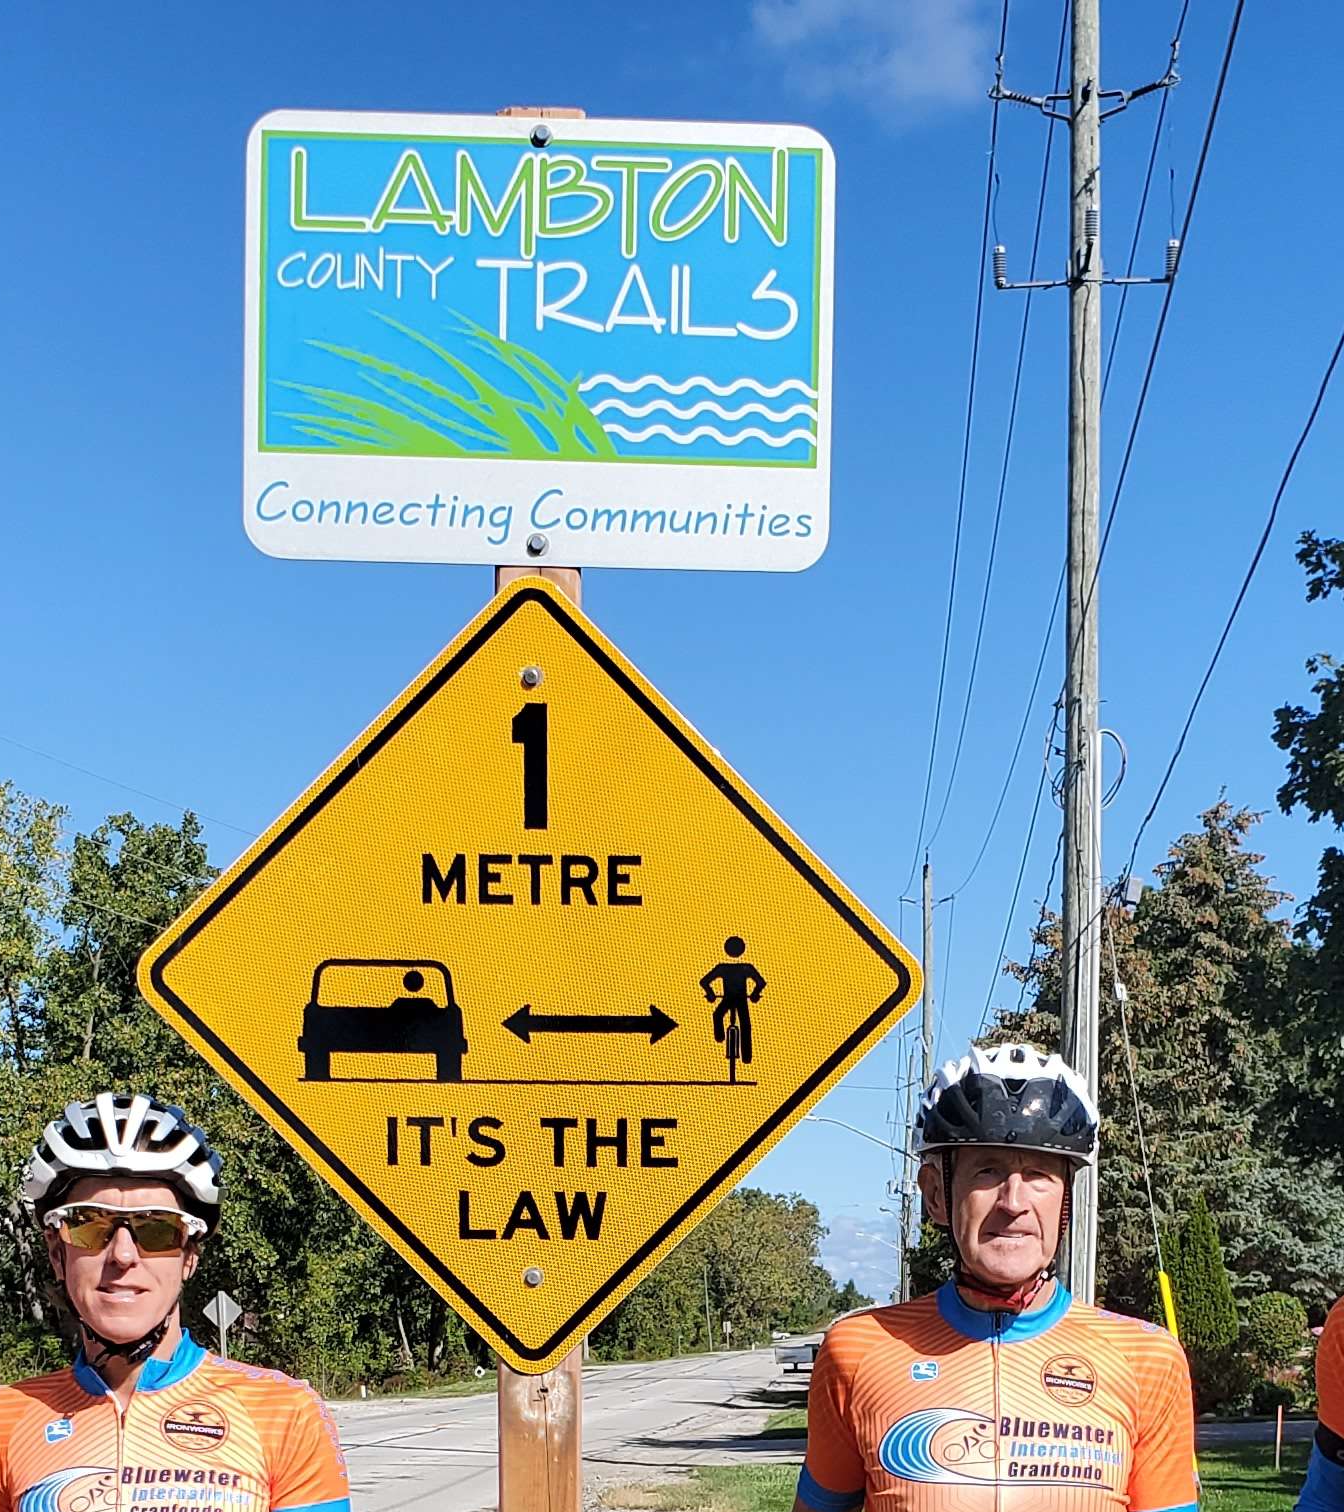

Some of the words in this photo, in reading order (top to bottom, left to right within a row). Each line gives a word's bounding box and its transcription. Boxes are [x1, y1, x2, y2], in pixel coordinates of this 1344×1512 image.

[290, 147, 789, 259] LAMBTON
[276, 247, 455, 300] COUNTY
[476, 259, 799, 343] TRAILS
[255, 481, 513, 545] Connecting
[529, 488, 812, 538] Communities
[511, 702, 548, 830] 1
[422, 853, 643, 906] METRE
[386, 1116, 505, 1168] IT'S
[540, 1117, 679, 1168] THE
[458, 1190, 607, 1241] LAW
[999, 1416, 1114, 1445] Bluewater
[1010, 1441, 1123, 1466] International
[121, 1466, 241, 1488] Bluewater
[1008, 1461, 1102, 1480] Granfondo
